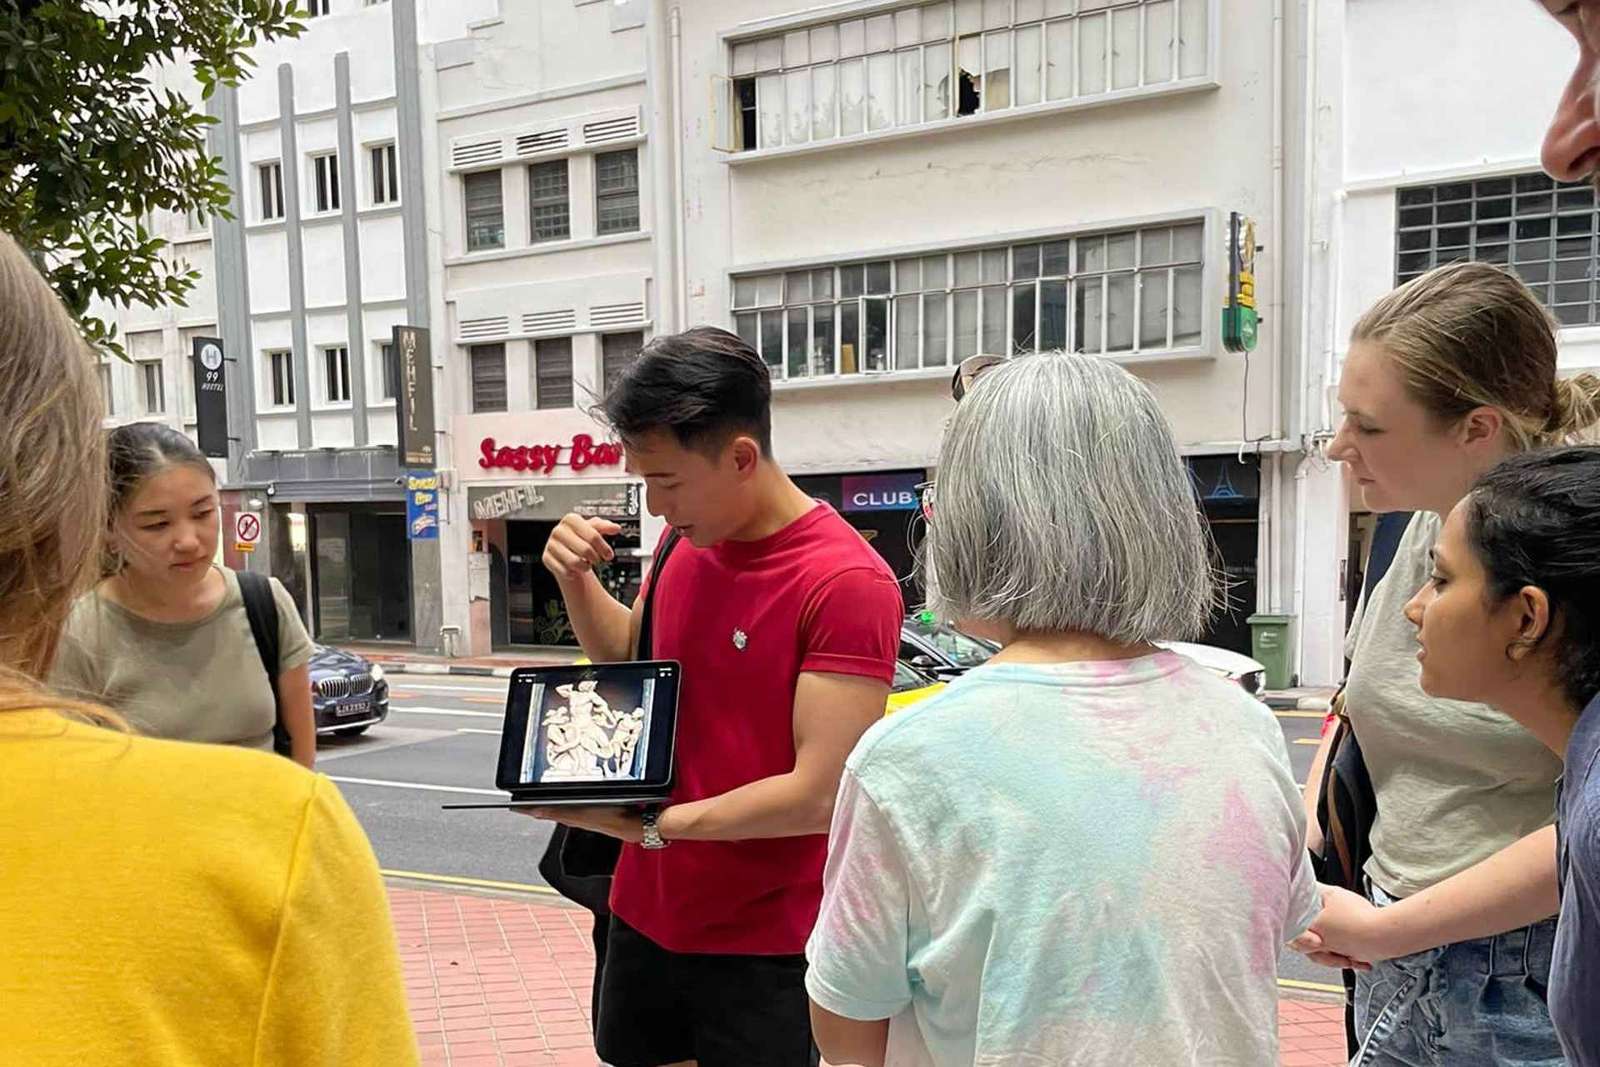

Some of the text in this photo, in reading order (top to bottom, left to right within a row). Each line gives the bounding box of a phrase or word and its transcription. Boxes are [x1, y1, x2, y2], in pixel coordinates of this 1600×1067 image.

[206, 371, 219, 381] 99
[402, 330, 419, 432] MEHFIL
[479, 437, 562, 474] Sassy
[473, 485, 545, 520] MEHFIL
[852, 491, 913, 506] CLUB
